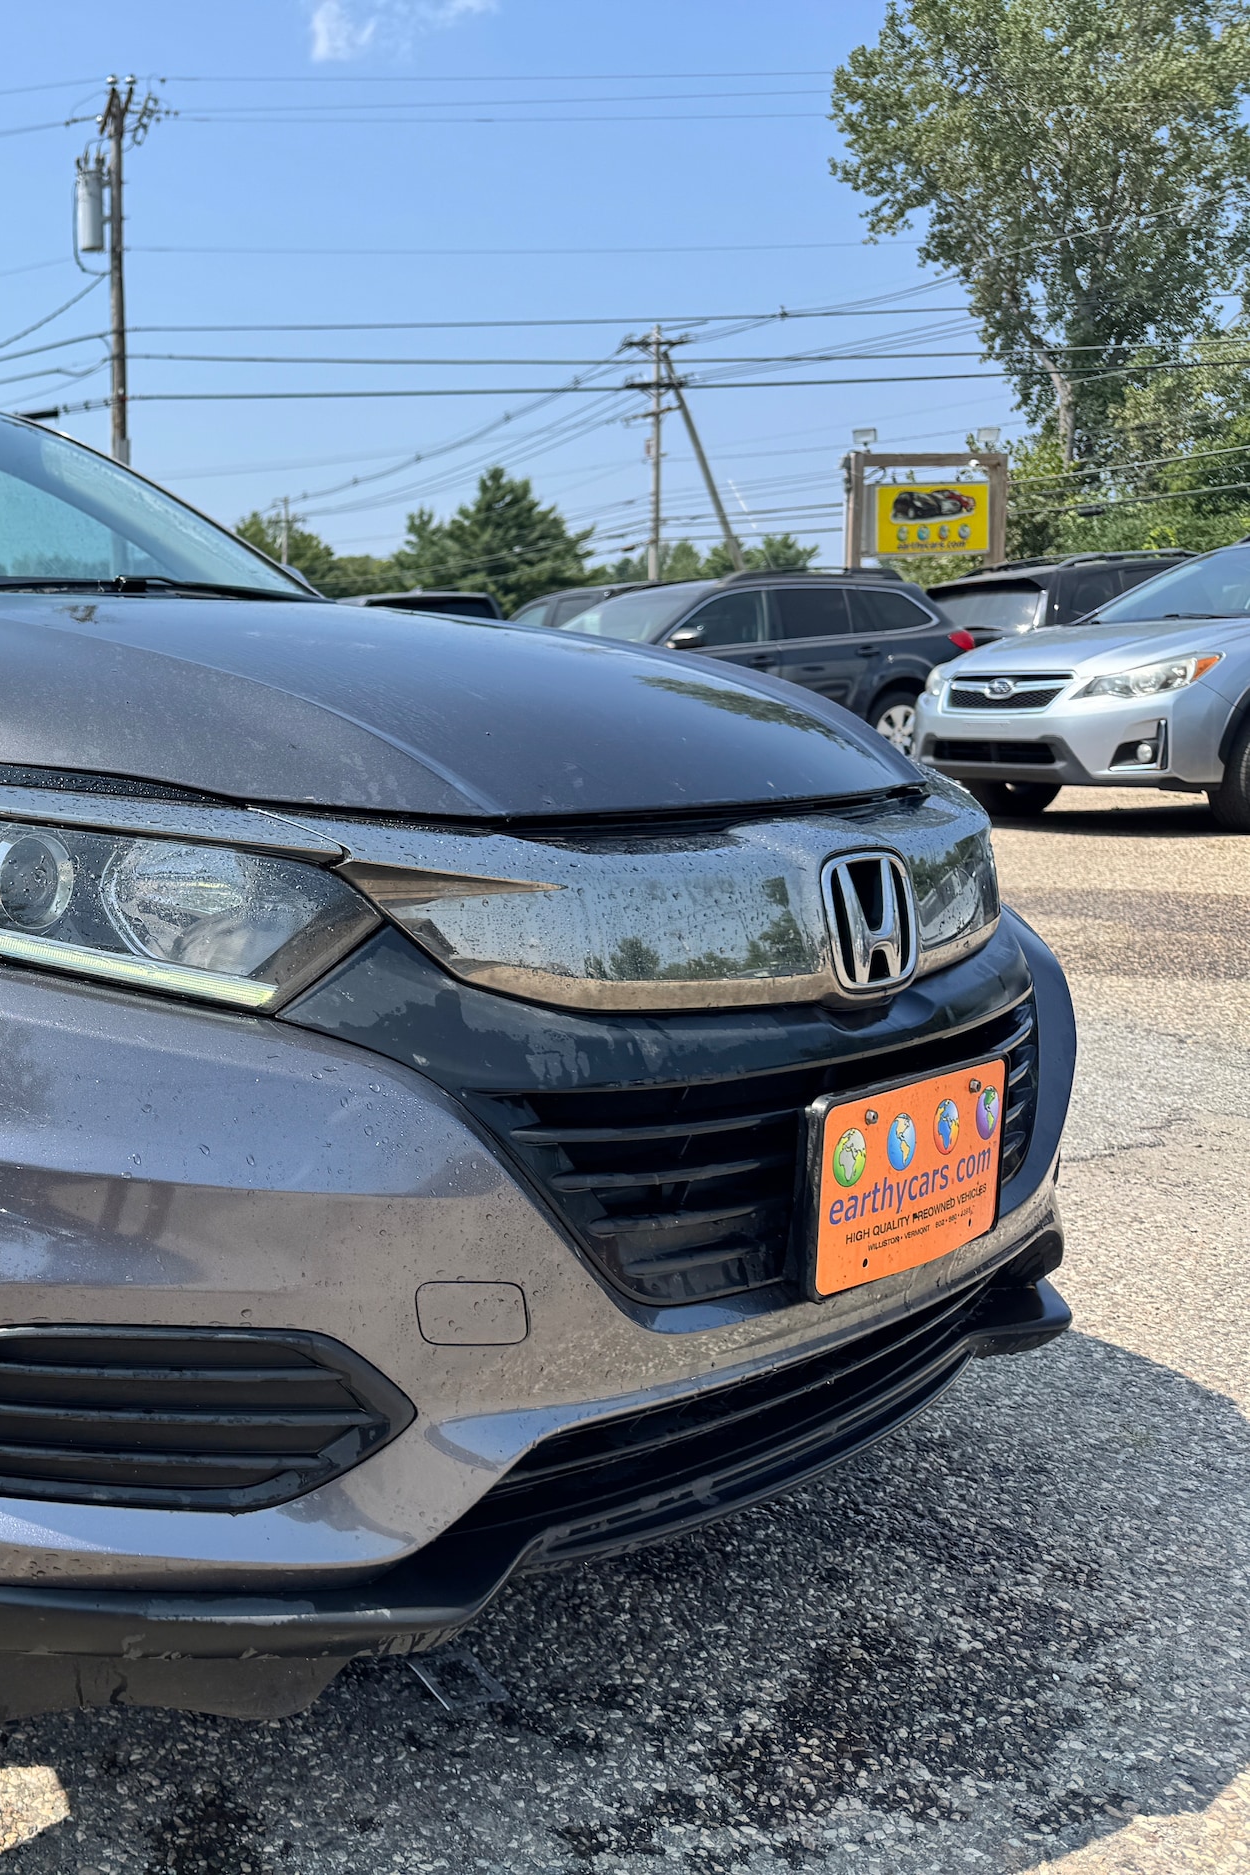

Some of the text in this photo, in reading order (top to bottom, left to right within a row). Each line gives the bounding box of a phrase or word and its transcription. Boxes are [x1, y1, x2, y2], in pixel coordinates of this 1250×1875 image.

[828, 1147, 992, 1226] earthycars.com
[845, 1227, 871, 1245] HIGH
[872, 1214, 911, 1237] QUALITY
[912, 1196, 956, 1223] PREOWNED
[957, 1183, 987, 1206] VEHICLES
[904, 1224, 931, 1240] VERMONT
